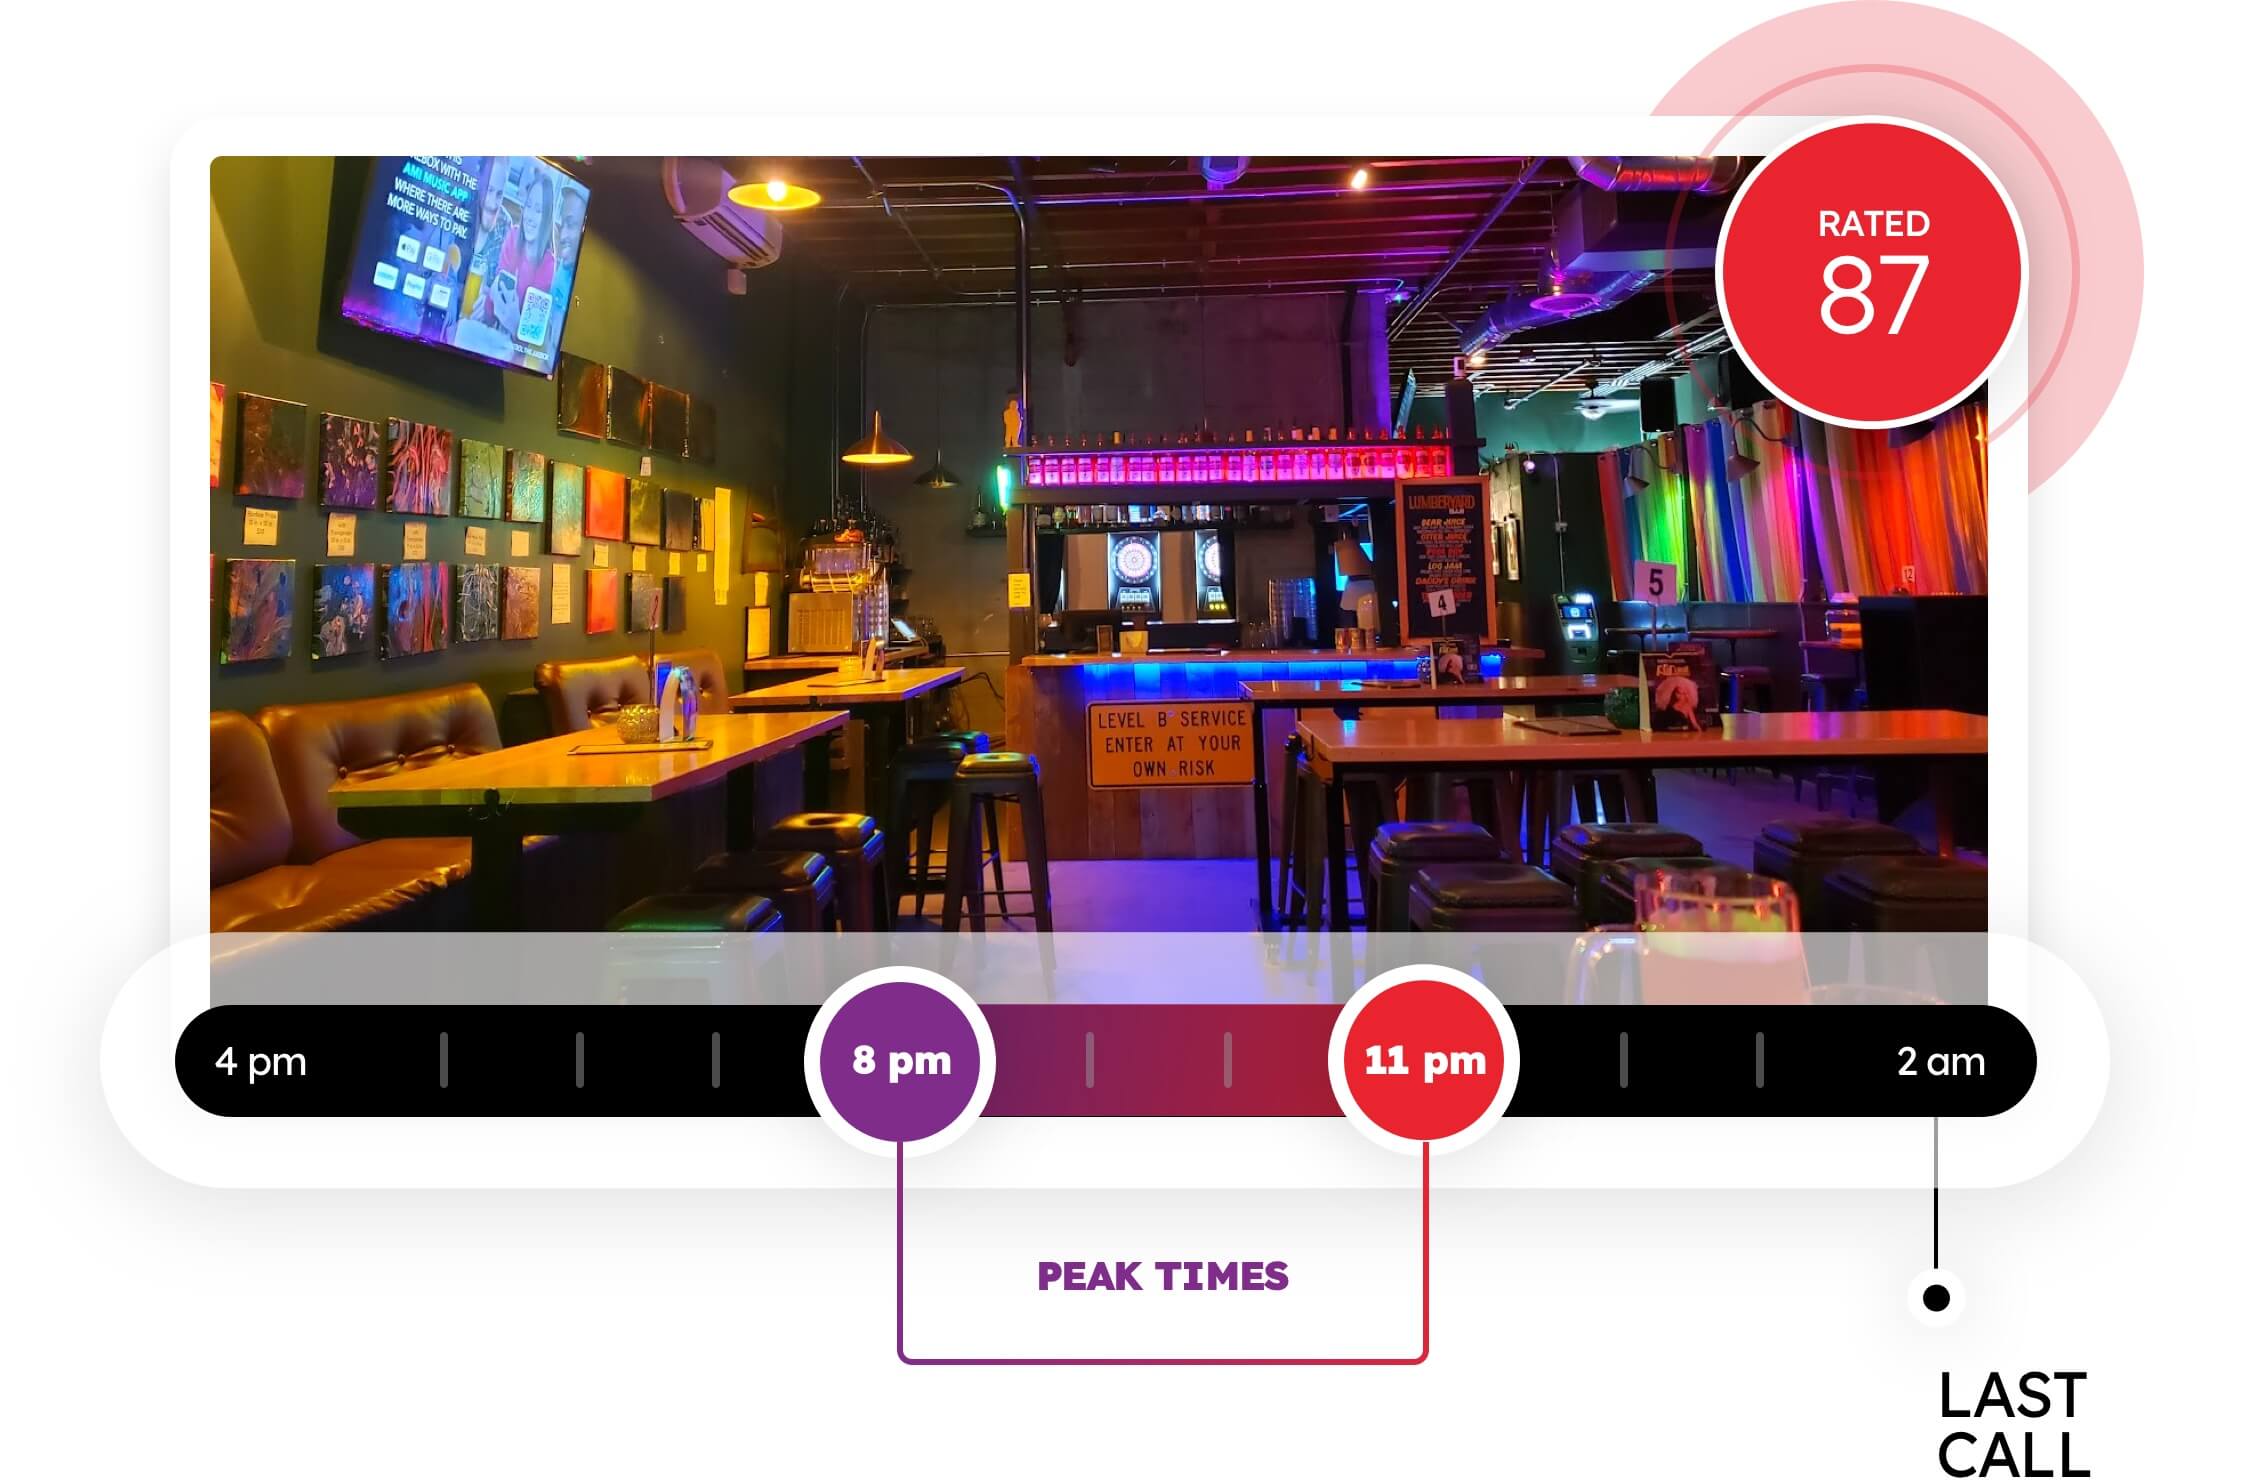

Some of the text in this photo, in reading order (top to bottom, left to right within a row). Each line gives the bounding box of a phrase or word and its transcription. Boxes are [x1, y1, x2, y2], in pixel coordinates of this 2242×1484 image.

[402, 161, 469, 202] AMI MUSIC APP
[440, 161, 462, 182] WITH
[462, 172, 478, 190] THE
[394, 176, 471, 222] WHERE THERE ARE
[387, 192, 415, 215] MORE
[415, 205, 440, 225] WAYS
[440, 216, 452, 231] TO
[1408, 495, 1476, 509] LUMBERYARD
[1649, 568, 1664, 596] 5
[1438, 594, 1447, 610] 4
[1098, 709, 1247, 729] LEVEL B SERVICE
[1105, 735, 1241, 753] ENTER AT YOUR
[1133, 759, 1215, 778] OWN RISK
